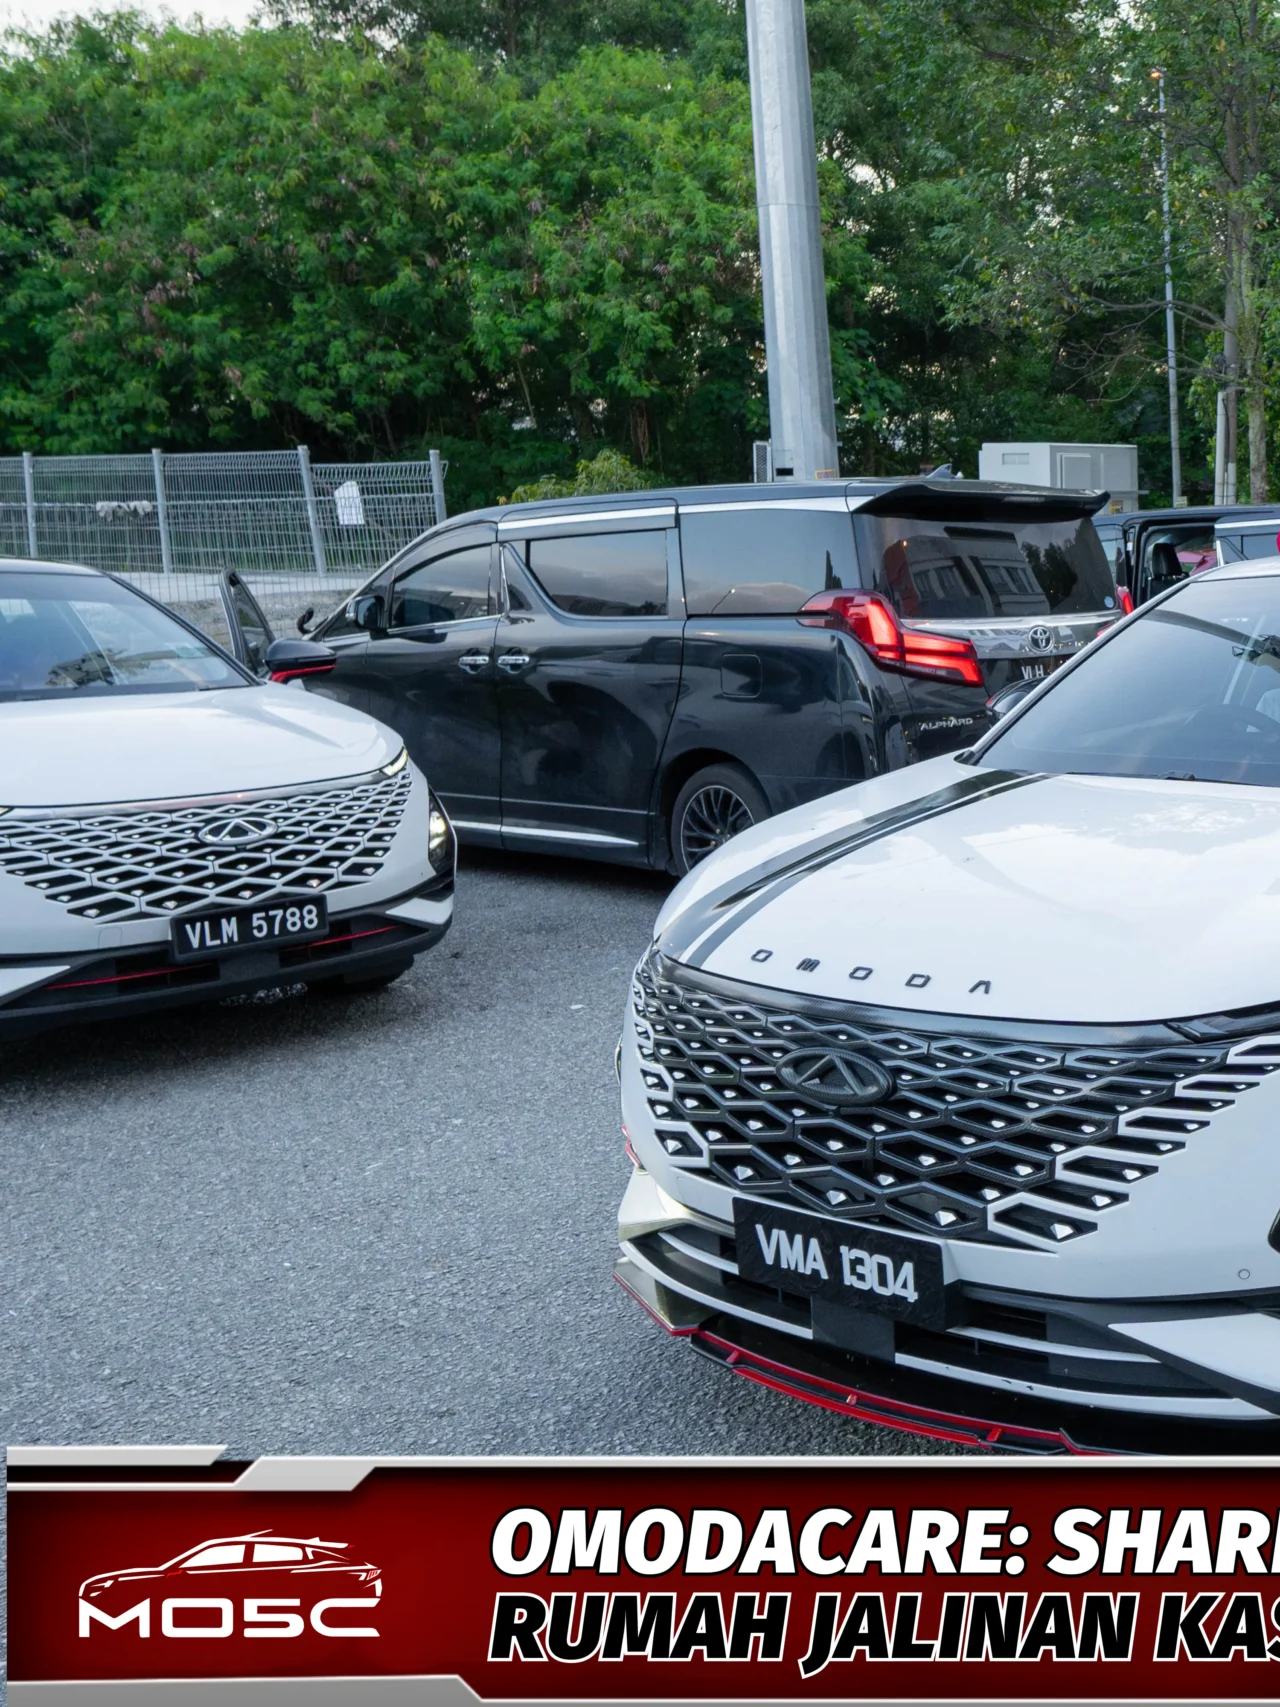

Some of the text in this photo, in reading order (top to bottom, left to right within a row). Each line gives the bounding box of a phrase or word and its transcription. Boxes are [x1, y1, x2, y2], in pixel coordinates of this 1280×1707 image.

[920, 717, 973, 731] ALPHARD
[185, 904, 319, 949] VLM 5788
[751, 948, 992, 995] OMODA
[755, 1223, 919, 1303] VMA 1304
